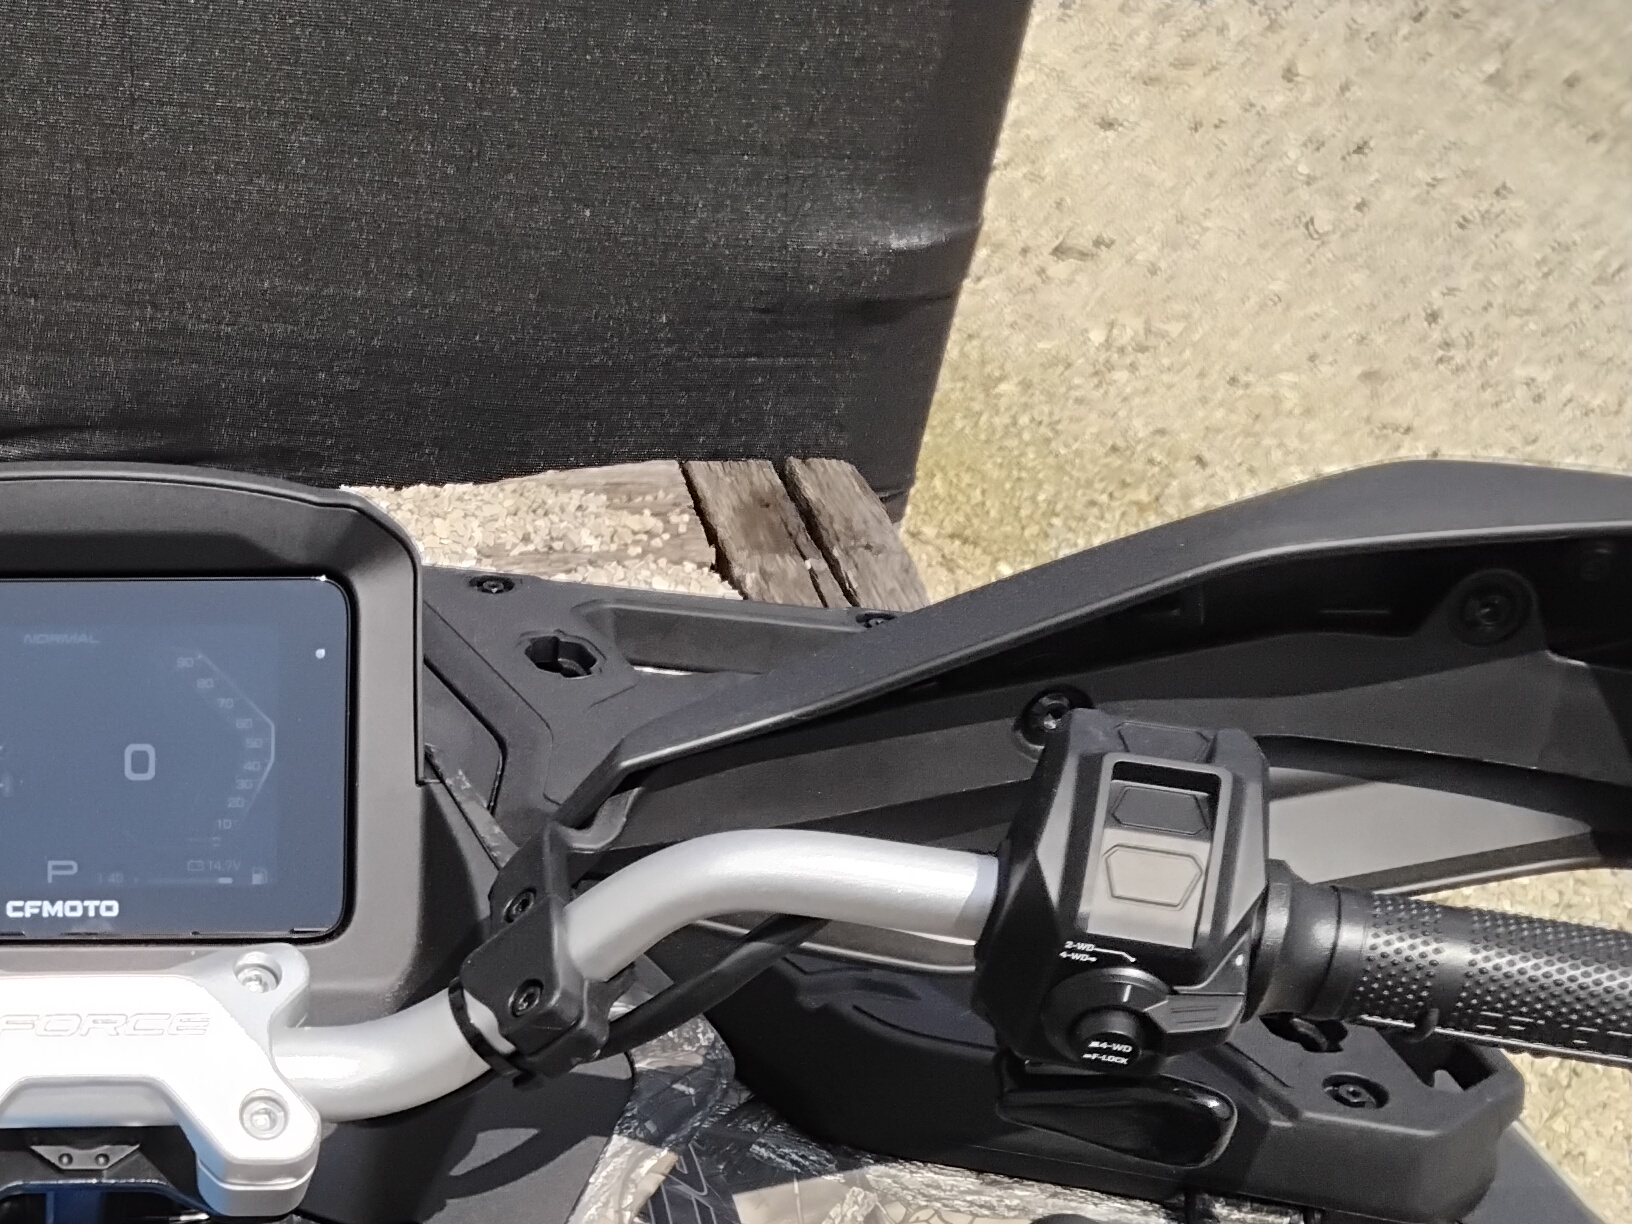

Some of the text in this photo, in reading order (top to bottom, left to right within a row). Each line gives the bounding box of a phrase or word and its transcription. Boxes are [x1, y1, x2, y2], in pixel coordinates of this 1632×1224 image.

[23, 633, 100, 645] NORMAL
[246, 738, 263, 748] 50
[124, 743, 156, 781] 0
[244, 760, 261, 771] 40
[236, 779, 253, 790] 30
[228, 798, 245, 808] 20
[217, 819, 232, 830] 10
[47, 859, 78, 883] P
[5, 899, 120, 918] CFMOTO
[1065, 941, 1095, 952] 2-WD
[1059, 951, 1089, 961] 4-WD
[1099, 1042, 1133, 1053] 4-WD
[1091, 1053, 1129, 1065] F-LOCK
